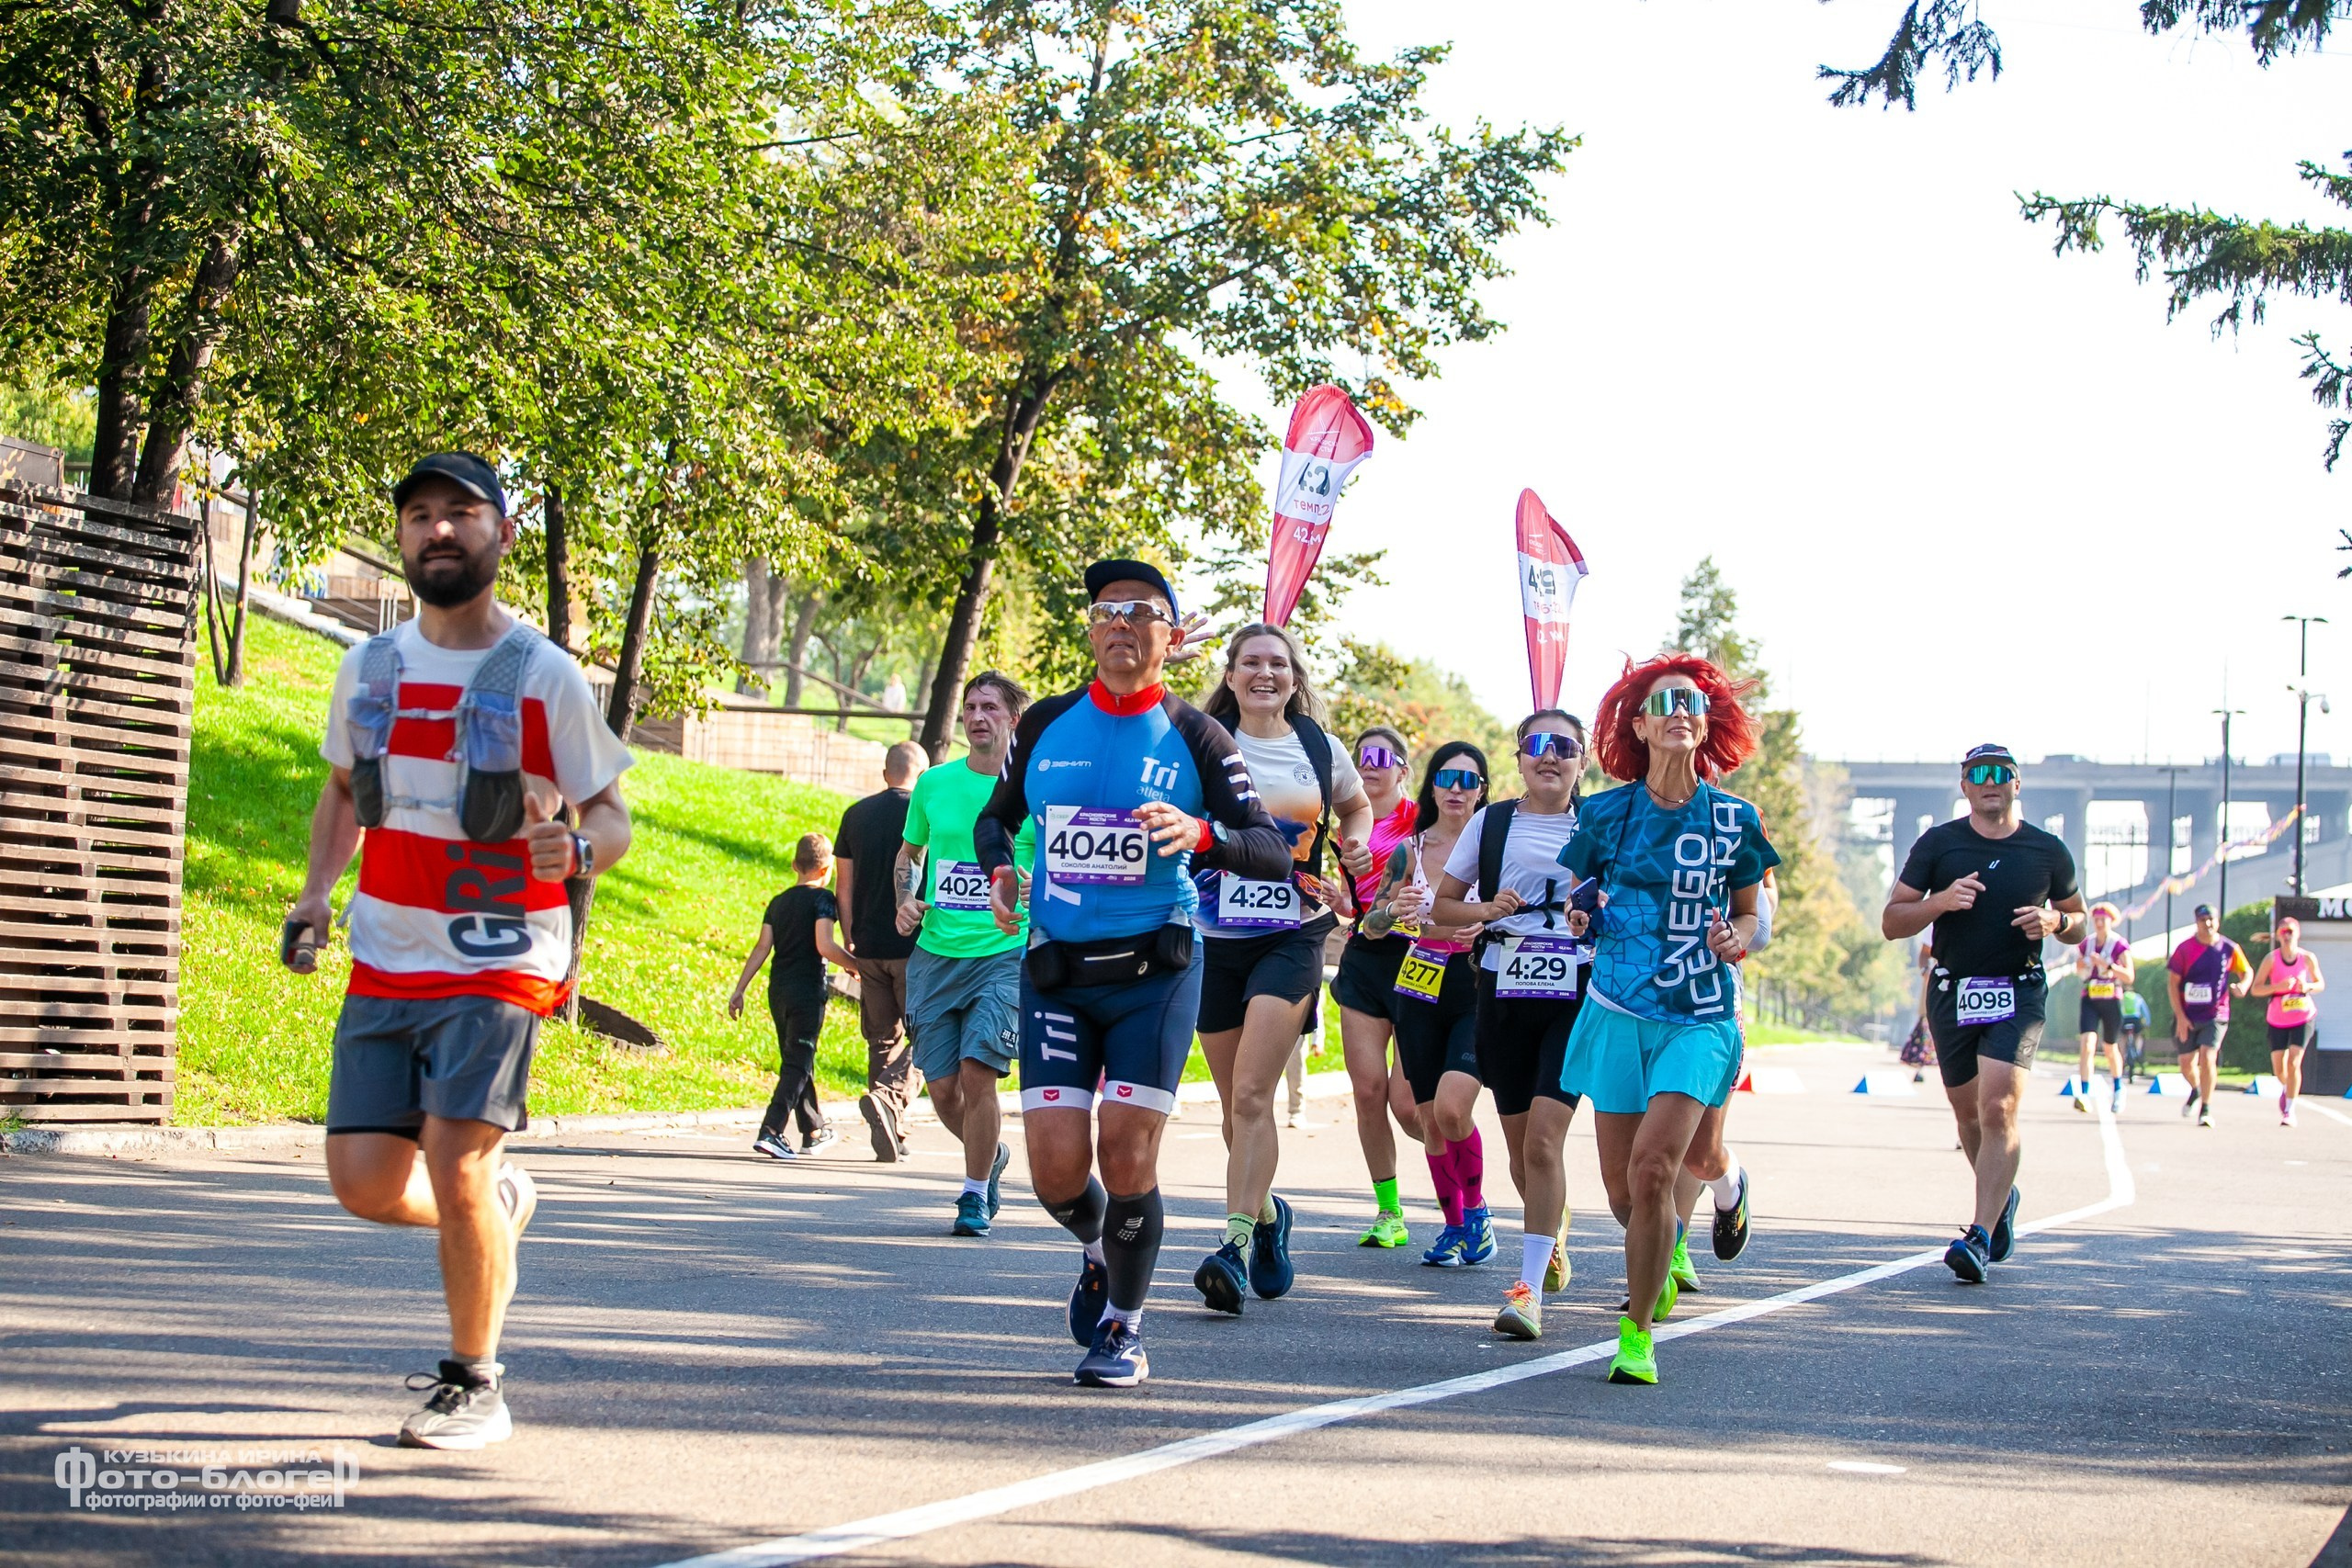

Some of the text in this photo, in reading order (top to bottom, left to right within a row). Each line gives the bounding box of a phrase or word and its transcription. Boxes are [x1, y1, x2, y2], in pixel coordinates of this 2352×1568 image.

[1140, 756, 1181, 790] Tri
[1136, 784, 1170, 803] atleta
[1048, 830, 1144, 863] 4046
[1229, 885, 1291, 909] 4:29
[1506, 956, 1566, 981] 4:29
[1687, 949, 1724, 1016] ICE
[1958, 991, 2012, 1011] 4098
[1035, 1011, 1077, 1061] Tri
